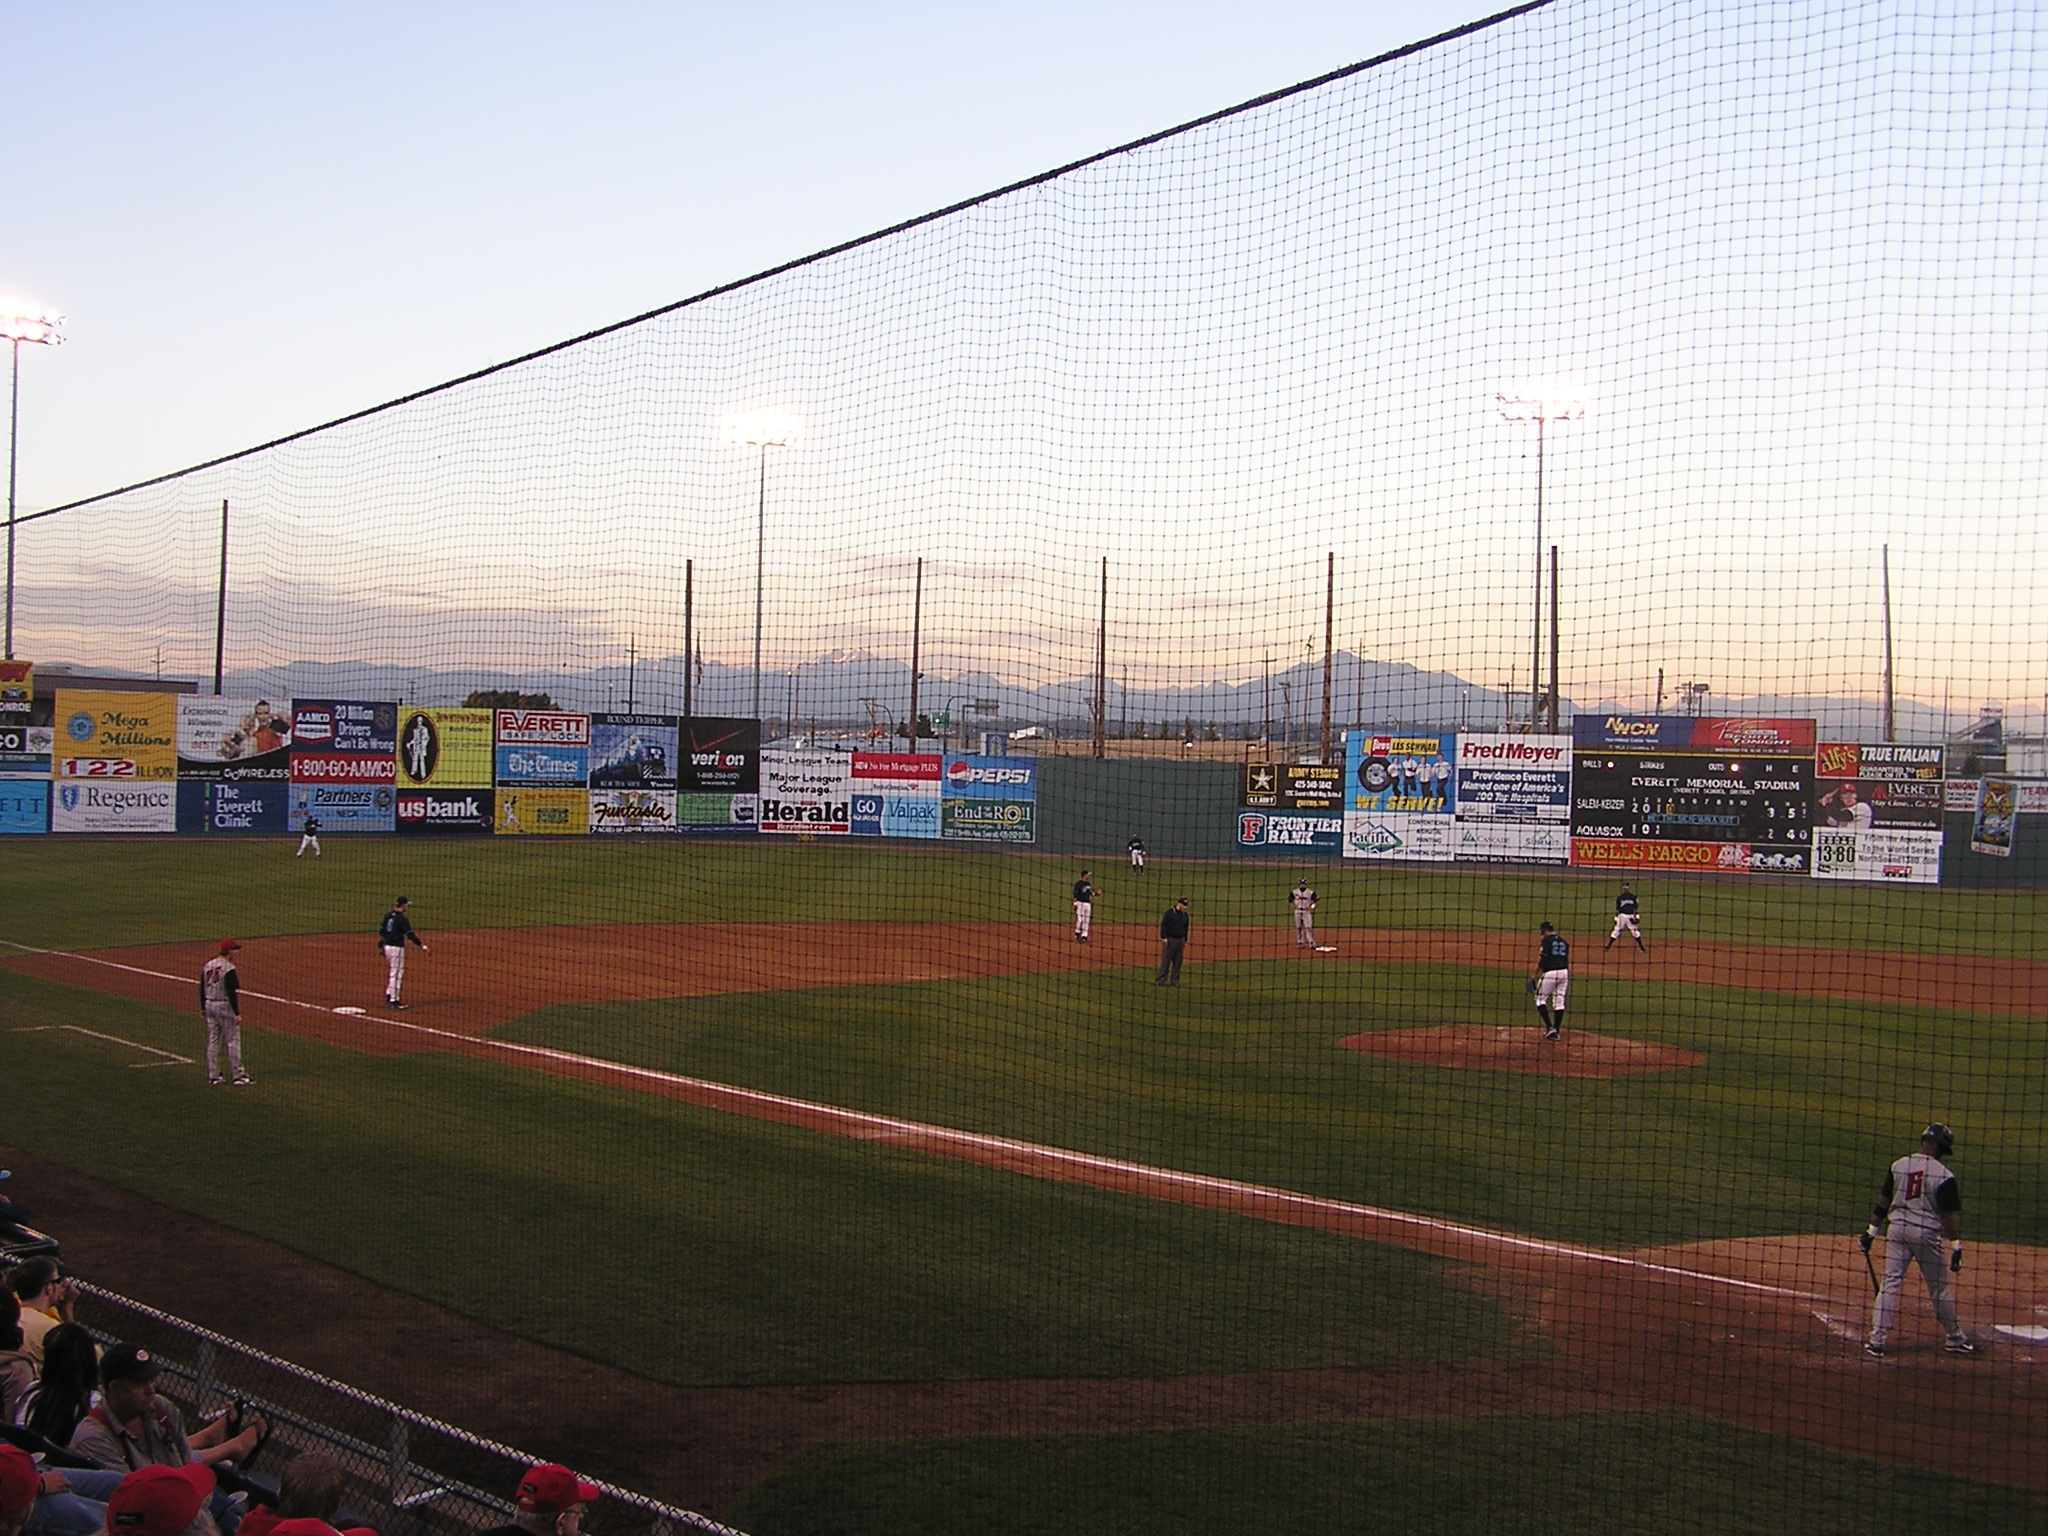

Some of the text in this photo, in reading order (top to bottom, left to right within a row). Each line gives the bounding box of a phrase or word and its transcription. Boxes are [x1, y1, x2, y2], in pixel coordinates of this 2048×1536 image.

[296, 712, 331, 722] AAMCO
[334, 705, 374, 720] 20 Million
[101, 712, 149, 730] Mega
[339, 721, 371, 736] Drivers
[503, 716, 583, 732] EVERETT
[1605, 717, 1660, 735] NWCN
[100, 732, 171, 746] Millions
[506, 731, 534, 739] SAFE
[334, 738, 394, 752] Can't Be Wrong
[1392, 742, 1404, 751] LES
[1406, 742, 1437, 752] SCHWAB
[1462, 742, 1564, 763] Fred Meyer
[508, 754, 578, 774] The Times
[691, 751, 744, 769] verizon
[789, 756, 822, 766] League
[1582, 760, 1601, 768] BALLS
[1708, 763, 1725, 771] OUTS
[1765, 764, 1773, 772] H
[1792, 765, 1799, 773] E
[1820, 746, 1939, 773] Alfy's TRUE ITALIAN
[292, 759, 396, 777] 1-800-GO-AAMCO
[921, 763, 938, 772] PLUS
[770, 773, 842, 785] Major League
[969, 768, 1031, 784] PEPSI
[1473, 771, 1556, 782] Providence Everett
[1631, 777, 1800, 790] EVERETT MEMORIAL STADIUM
[215, 784, 239, 798] The
[1462, 781, 1565, 792] Named one of America's
[87, 787, 169, 814] Regence
[315, 788, 372, 803] Partners
[1495, 792, 1509, 803] Top
[1510, 793, 1550, 803] Hospitals
[216, 799, 263, 812] Everett
[593, 802, 672, 824] Funtasia
[762, 800, 849, 822] Herald
[857, 800, 876, 814] GO
[890, 797, 935, 823] Valpak
[954, 804, 1031, 821] End Roll
[1576, 798, 1625, 810] SALEM-KEIZER
[1632, 803, 1638, 813] 2
[1643, 804, 1650, 813] 0
[1767, 807, 1775, 818] 3
[1788, 808, 1796, 819] 5
[215, 814, 252, 827] Clinic
[1268, 816, 1342, 833] FRONTIER
[1242, 818, 1263, 841] F
[1576, 825, 1623, 836] AQUASOX
[1642, 824, 1649, 834] 0
[1768, 828, 1774, 839] 2
[1786, 829, 1795, 839] 4
[1799, 830, 1807, 840] 0
[1267, 830, 1314, 845] BANK
[1349, 831, 1390, 844] Pacific
[1575, 842, 1711, 863] WELLS FARGO
[1862, 844, 1870, 852] To
[1887, 845, 1909, 853] World
[1911, 846, 1935, 854] Series
[1552, 941, 1566, 956] 22
[1905, 1170, 1924, 1200] 6
